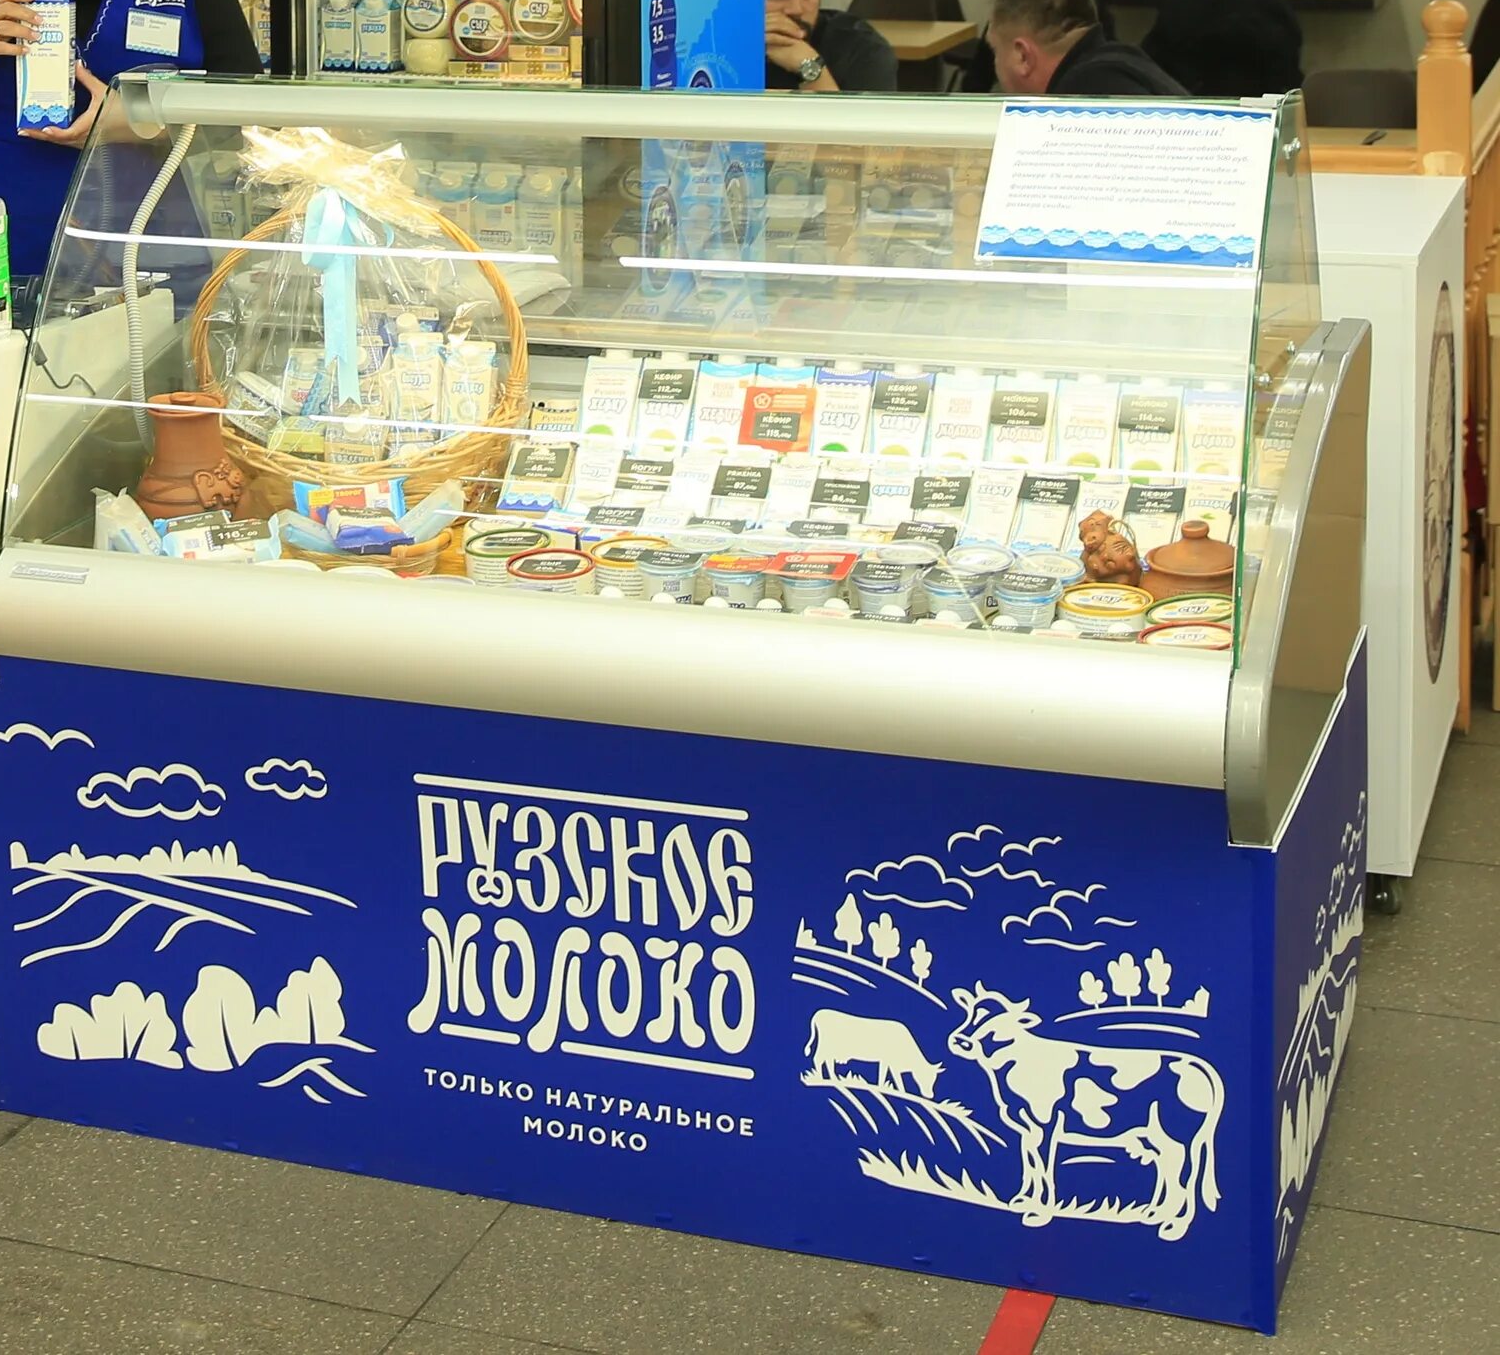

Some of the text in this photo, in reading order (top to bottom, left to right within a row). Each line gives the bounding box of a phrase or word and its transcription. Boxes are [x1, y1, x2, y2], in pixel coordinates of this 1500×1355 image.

[529, 2, 549, 17] СЫР
[469, 18, 489, 34] СЫР
[887, 384, 918, 393] КЕФИР
[1003, 395, 1039, 404] МОЛОКО
[1131, 399, 1168, 408] МОЛОКО
[762, 416, 792, 425] КЕФИР
[631, 463, 663, 473] ЙОГУРТ
[924, 480, 960, 488] СНЕЖОК
[598, 509, 636, 517] ЙОГУРТ
[417, 794, 754, 937] РУЗСКОЕ
[407, 907, 756, 1054] МОЛОКО
[424, 1067, 754, 1137] ТОЛЬКО НАТУРАЛЬНОЕ
[523, 1115, 647, 1152] МОЛОКО
